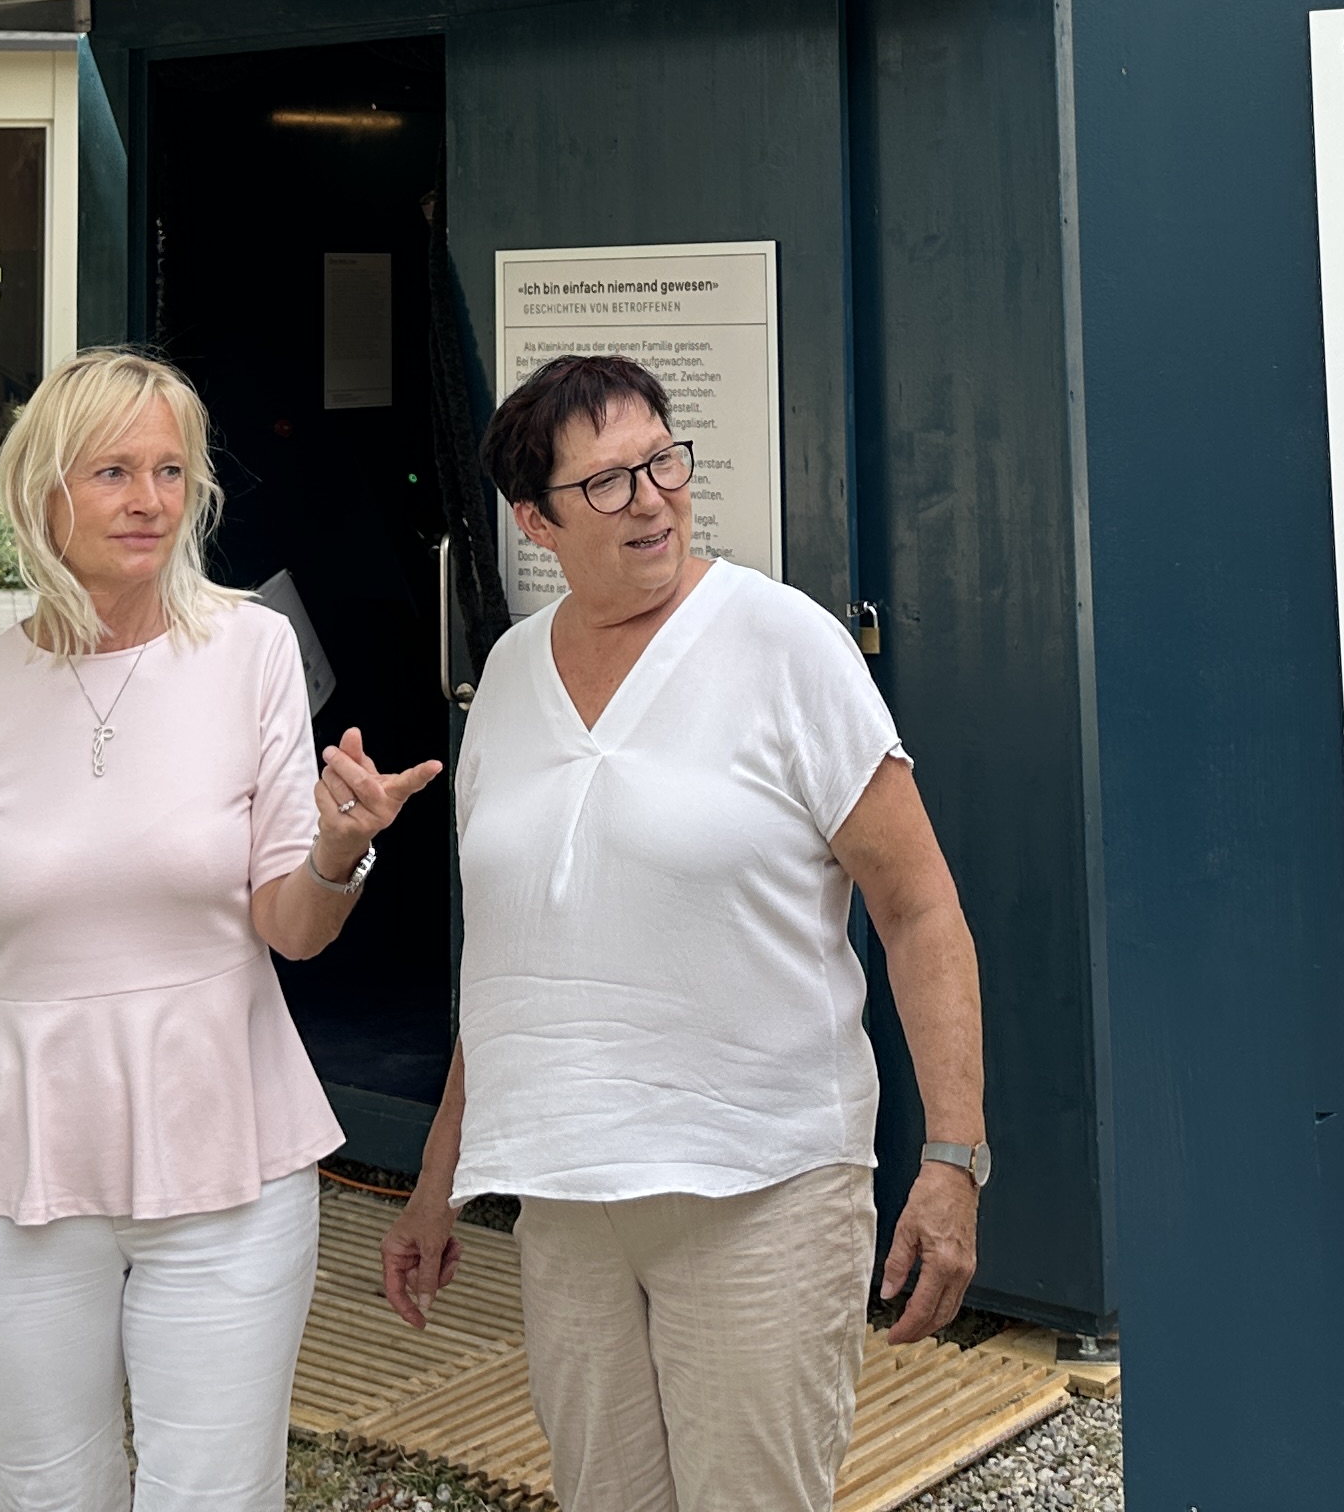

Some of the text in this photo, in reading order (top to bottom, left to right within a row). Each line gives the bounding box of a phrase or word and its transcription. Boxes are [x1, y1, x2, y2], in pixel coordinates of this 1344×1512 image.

[543, 281, 560, 295] bin
[563, 279, 605, 294] einfach
[607, 279, 658, 294] niemand
[523, 301, 681, 315] GESCHICHTEN VON BETROFFENEN
[537, 341, 575, 352] Kleinkind
[576, 342, 591, 352] aus
[592, 341, 606, 352] der
[607, 341, 641, 354] eigenen
[642, 340, 673, 352] Familie
[681, 370, 721, 382] Zwischen
